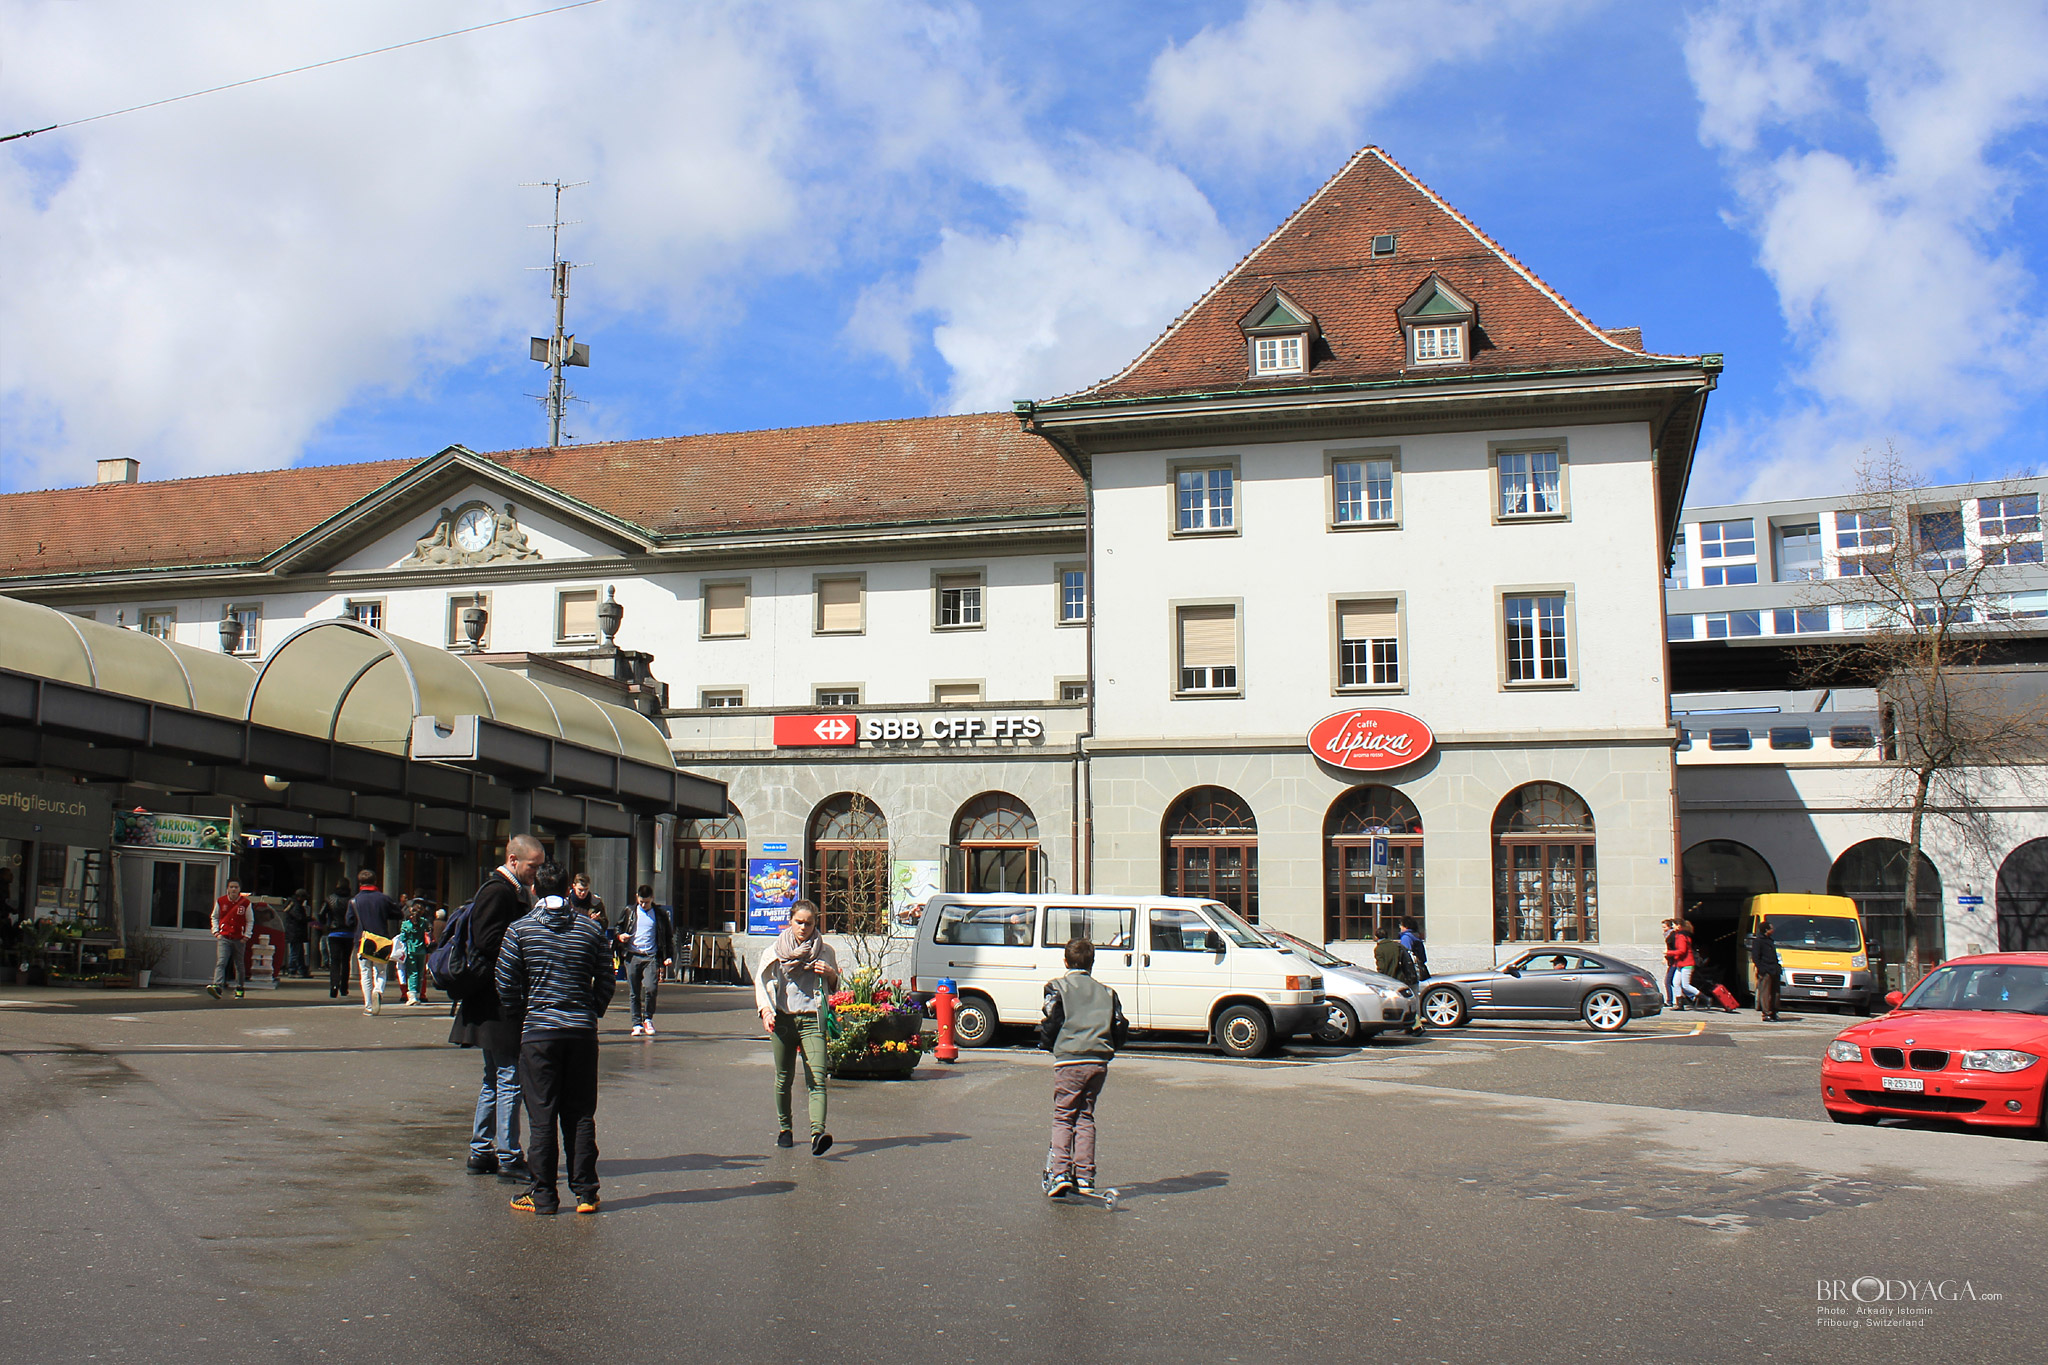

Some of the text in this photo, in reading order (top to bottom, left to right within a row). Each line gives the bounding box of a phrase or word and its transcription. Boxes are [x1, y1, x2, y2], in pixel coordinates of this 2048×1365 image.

[866, 715, 1041, 740] SBB CFF FFS
[1357, 720, 1378, 728] caffè
[1326, 713, 1413, 766] dipiaza
[155, 818, 198, 833] MARRONS
[156, 831, 192, 845] CHAUDS
[1377, 843, 1384, 862] P
